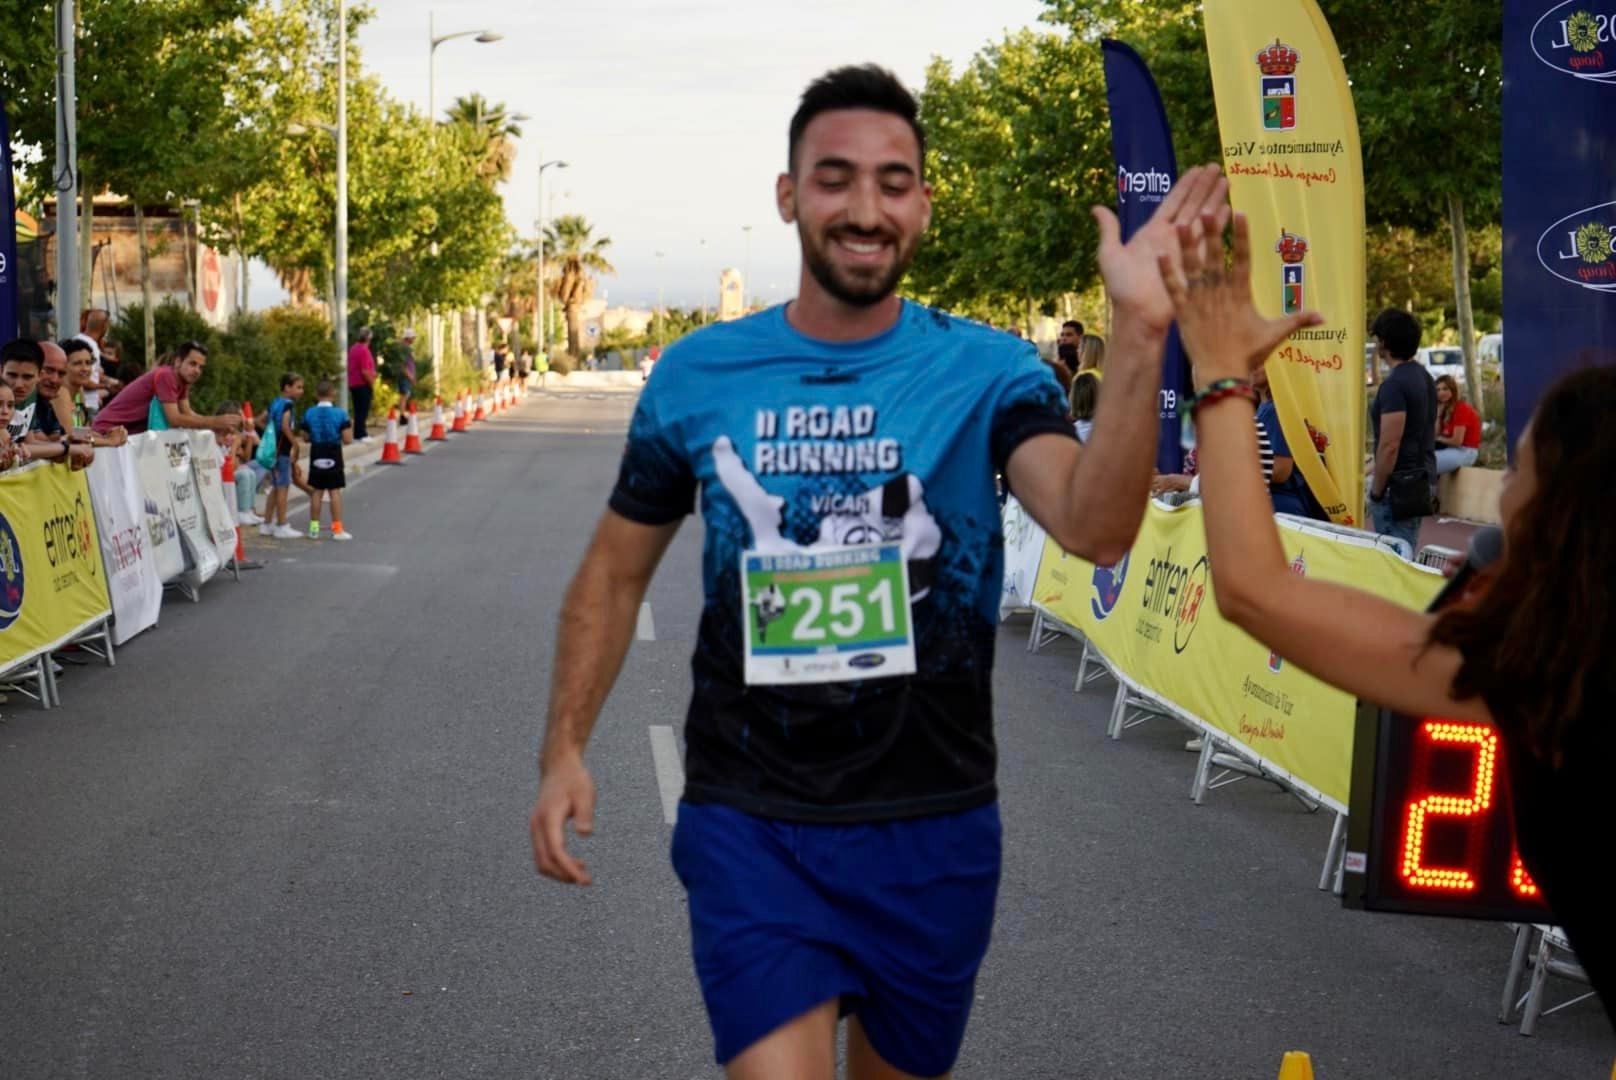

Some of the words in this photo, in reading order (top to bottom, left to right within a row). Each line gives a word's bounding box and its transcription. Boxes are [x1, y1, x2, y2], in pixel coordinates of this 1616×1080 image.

[756, 410, 777, 436] II
[787, 404, 876, 437] ROAD
[755, 438, 901, 474] RUNNING
[790, 578, 896, 641] 251
[1402, 722, 1537, 893] 2
